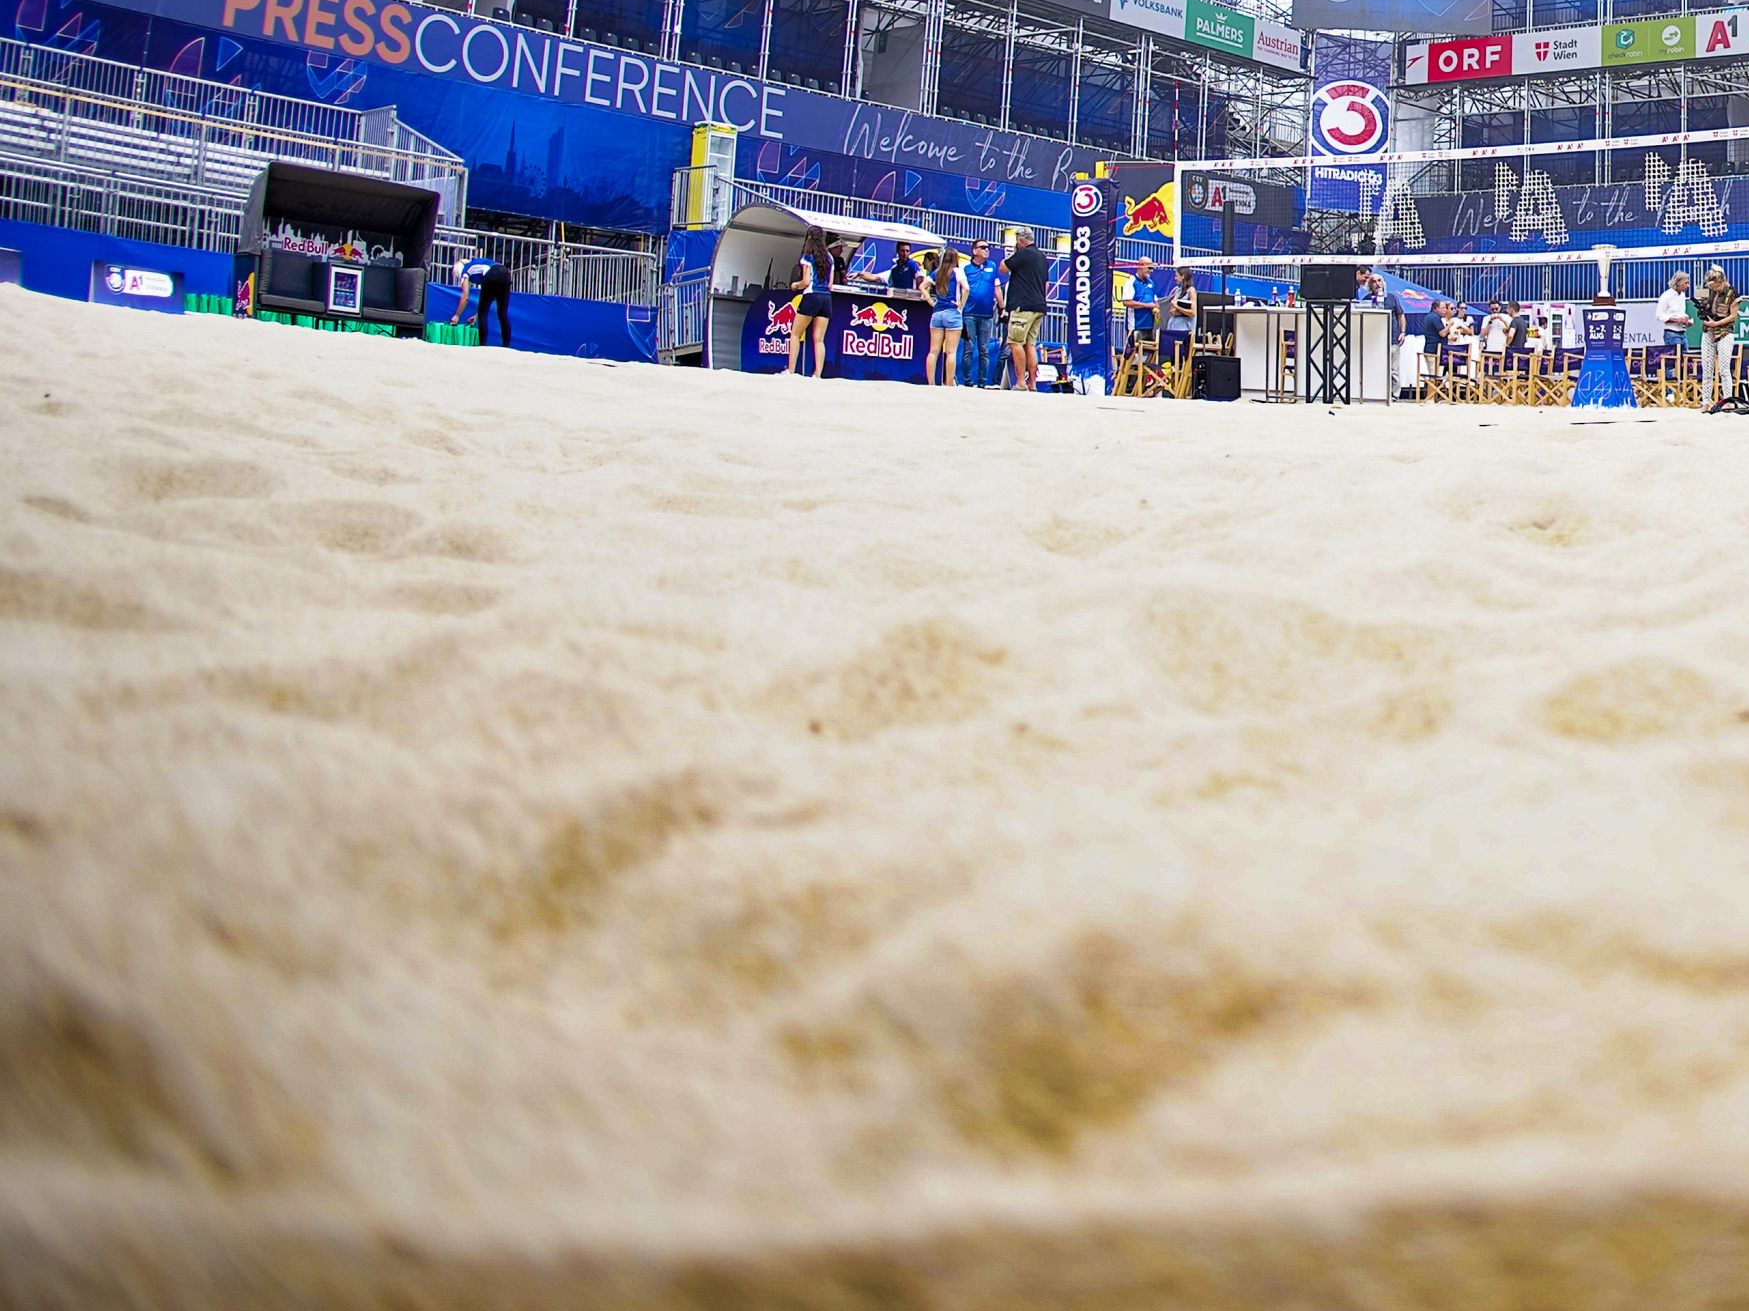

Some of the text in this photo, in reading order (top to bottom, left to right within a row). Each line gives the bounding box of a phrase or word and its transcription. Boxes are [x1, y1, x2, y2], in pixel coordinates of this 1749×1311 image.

[1196, 17, 1243, 43] PALMERS
[1257, 30, 1299, 55] Austrian
[1706, 15, 1738, 53] A1
[1553, 40, 1577, 50] Stadt
[1553, 50, 1577, 60] Wien
[1438, 46, 1501, 71] ORF
[844, 104, 963, 167] Welcome
[976, 130, 999, 171] to
[1003, 138, 1038, 179] the
[1211, 185, 1226, 207] A1
[283, 237, 328, 256] Red Bull
[1075, 256, 1091, 344] HITRADIO
[758, 337, 776, 354] Red
[842, 330, 914, 360] Red Bull
